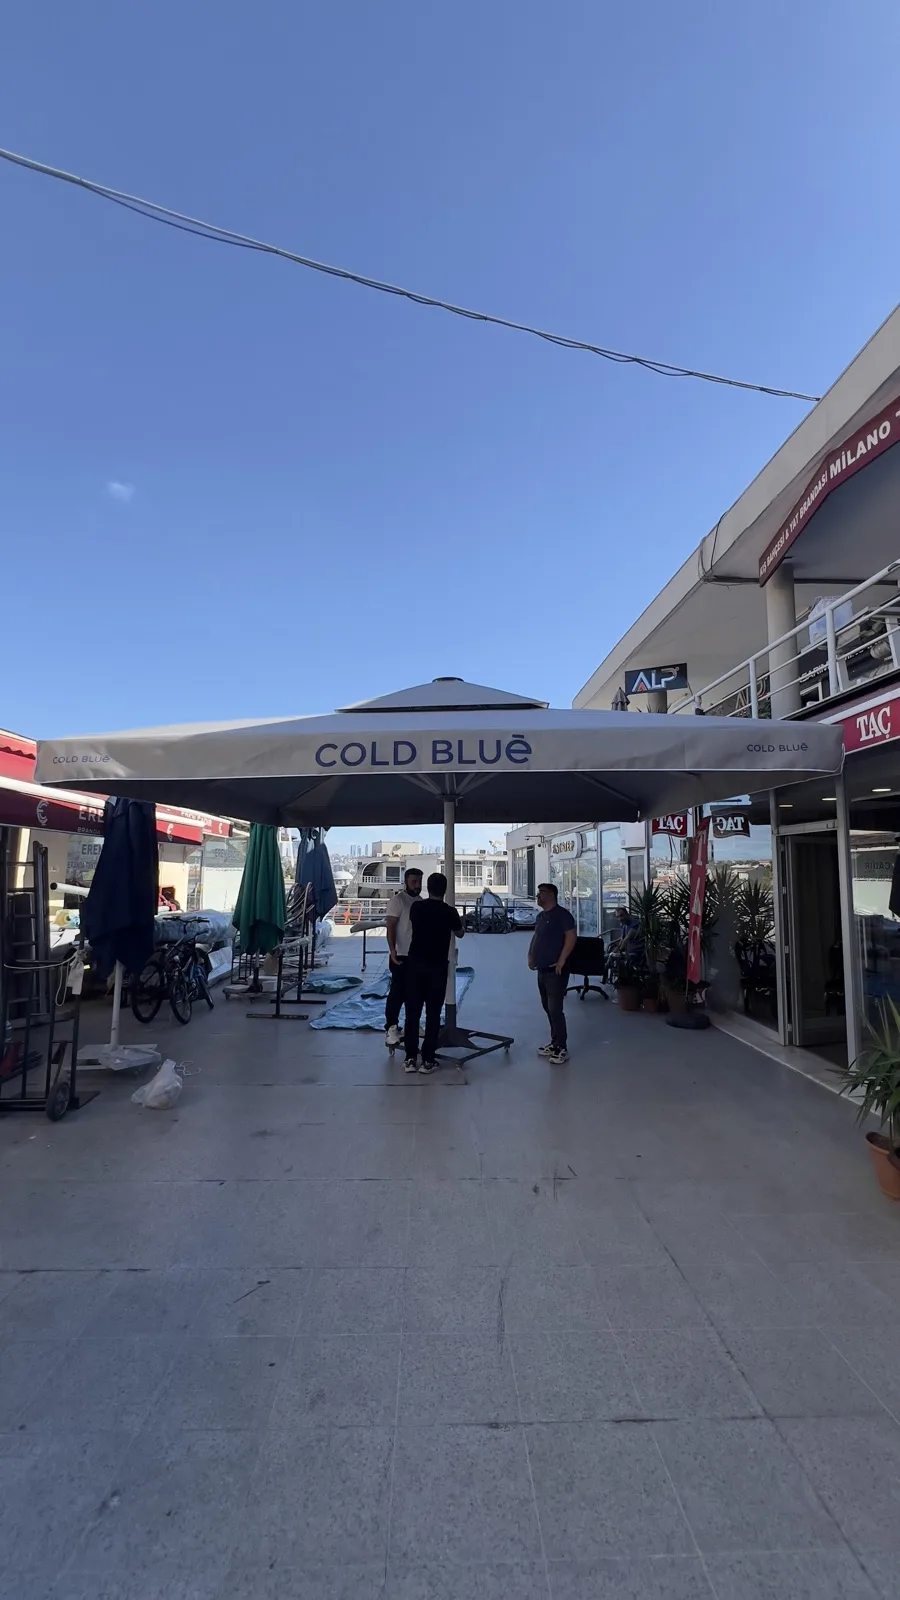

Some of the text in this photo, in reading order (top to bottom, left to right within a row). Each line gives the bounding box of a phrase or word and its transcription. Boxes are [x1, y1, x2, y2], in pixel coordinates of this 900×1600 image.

[829, 421, 891, 479] MİLANO
[789, 512, 799, 532] YAT
[632, 667, 679, 692] ALP
[856, 705, 891, 742] TAÇ
[315, 740, 417, 768] COLD
[747, 744, 776, 753] COLD
[52, 755, 79, 765] COLD
[657, 815, 684, 833] TAÇ
